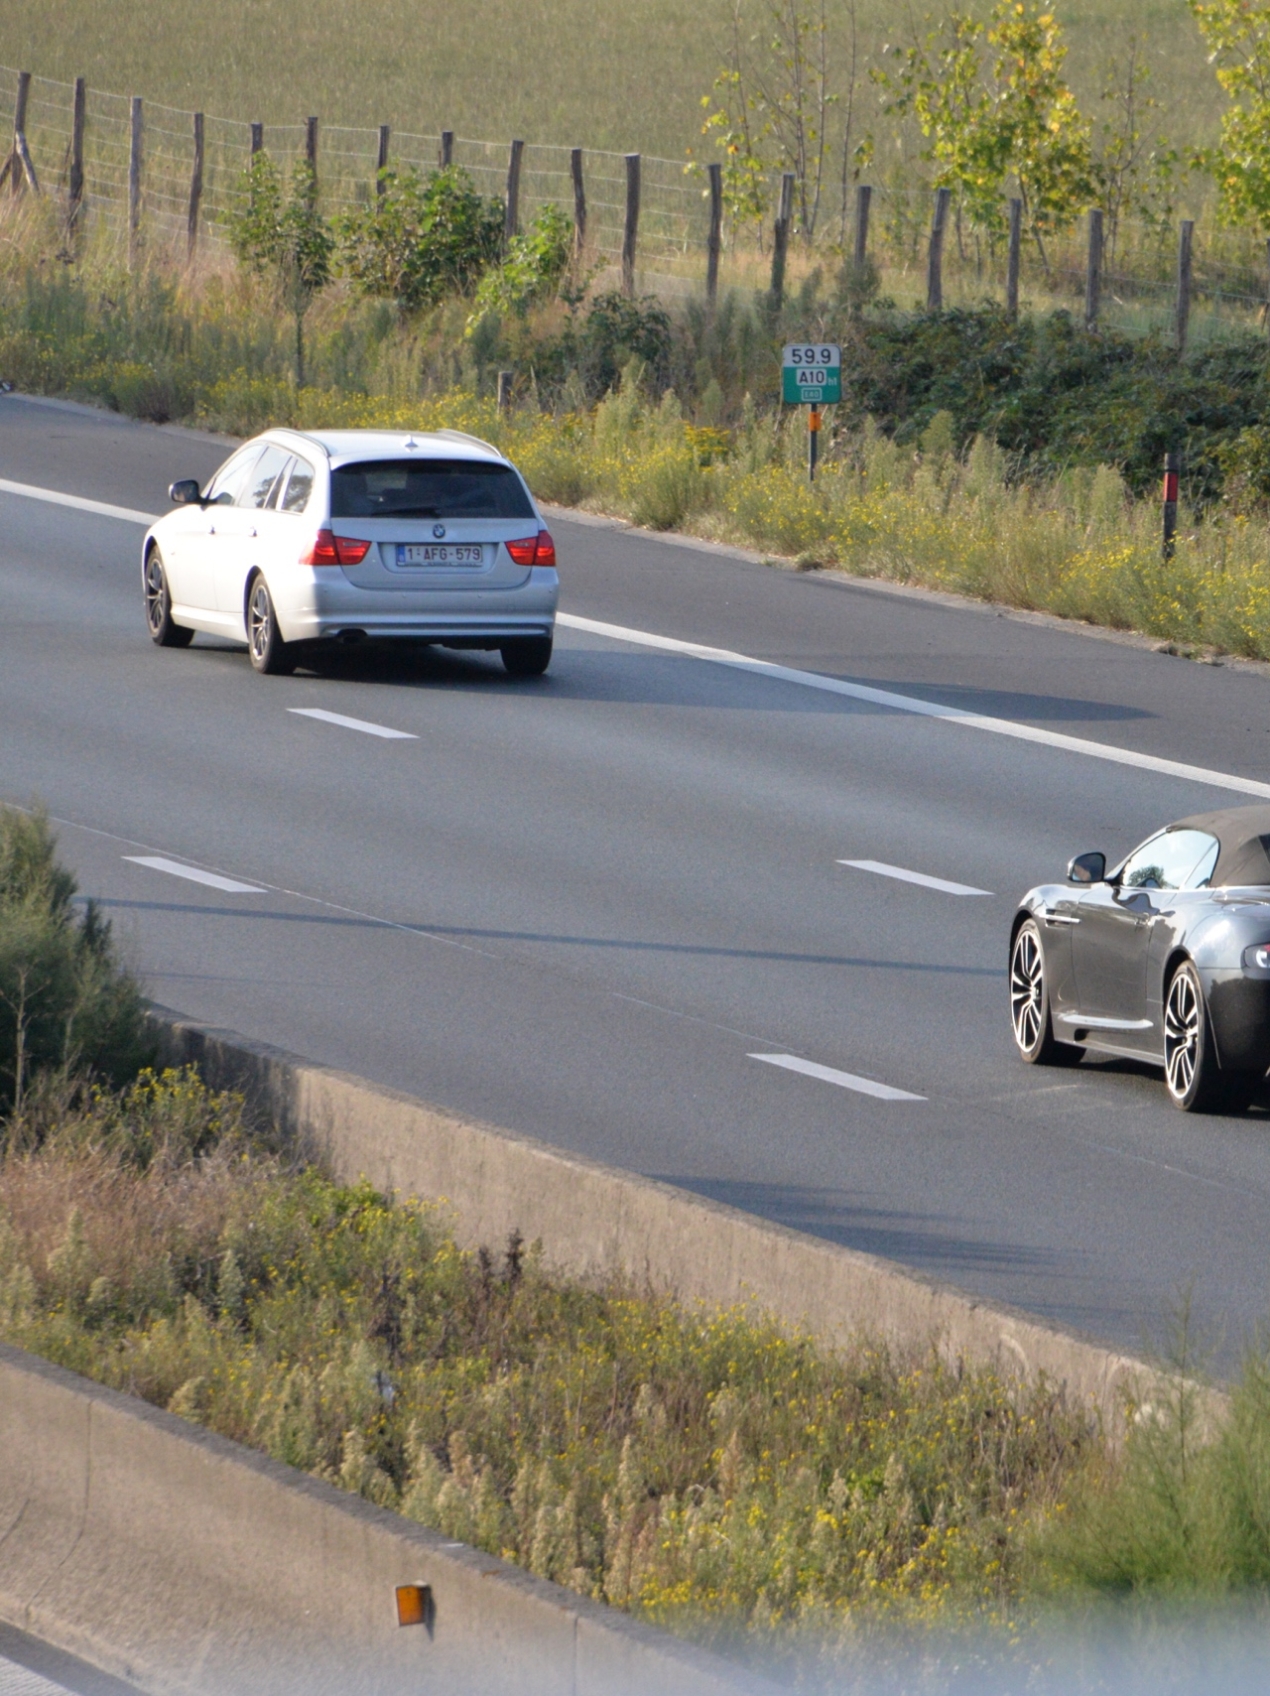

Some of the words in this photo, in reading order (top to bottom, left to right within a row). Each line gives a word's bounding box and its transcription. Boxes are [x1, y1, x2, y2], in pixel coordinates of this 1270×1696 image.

[792, 348, 831, 364] 59.9
[799, 370, 825, 384] A10
[407, 547, 480, 561] 1-AFG-579
